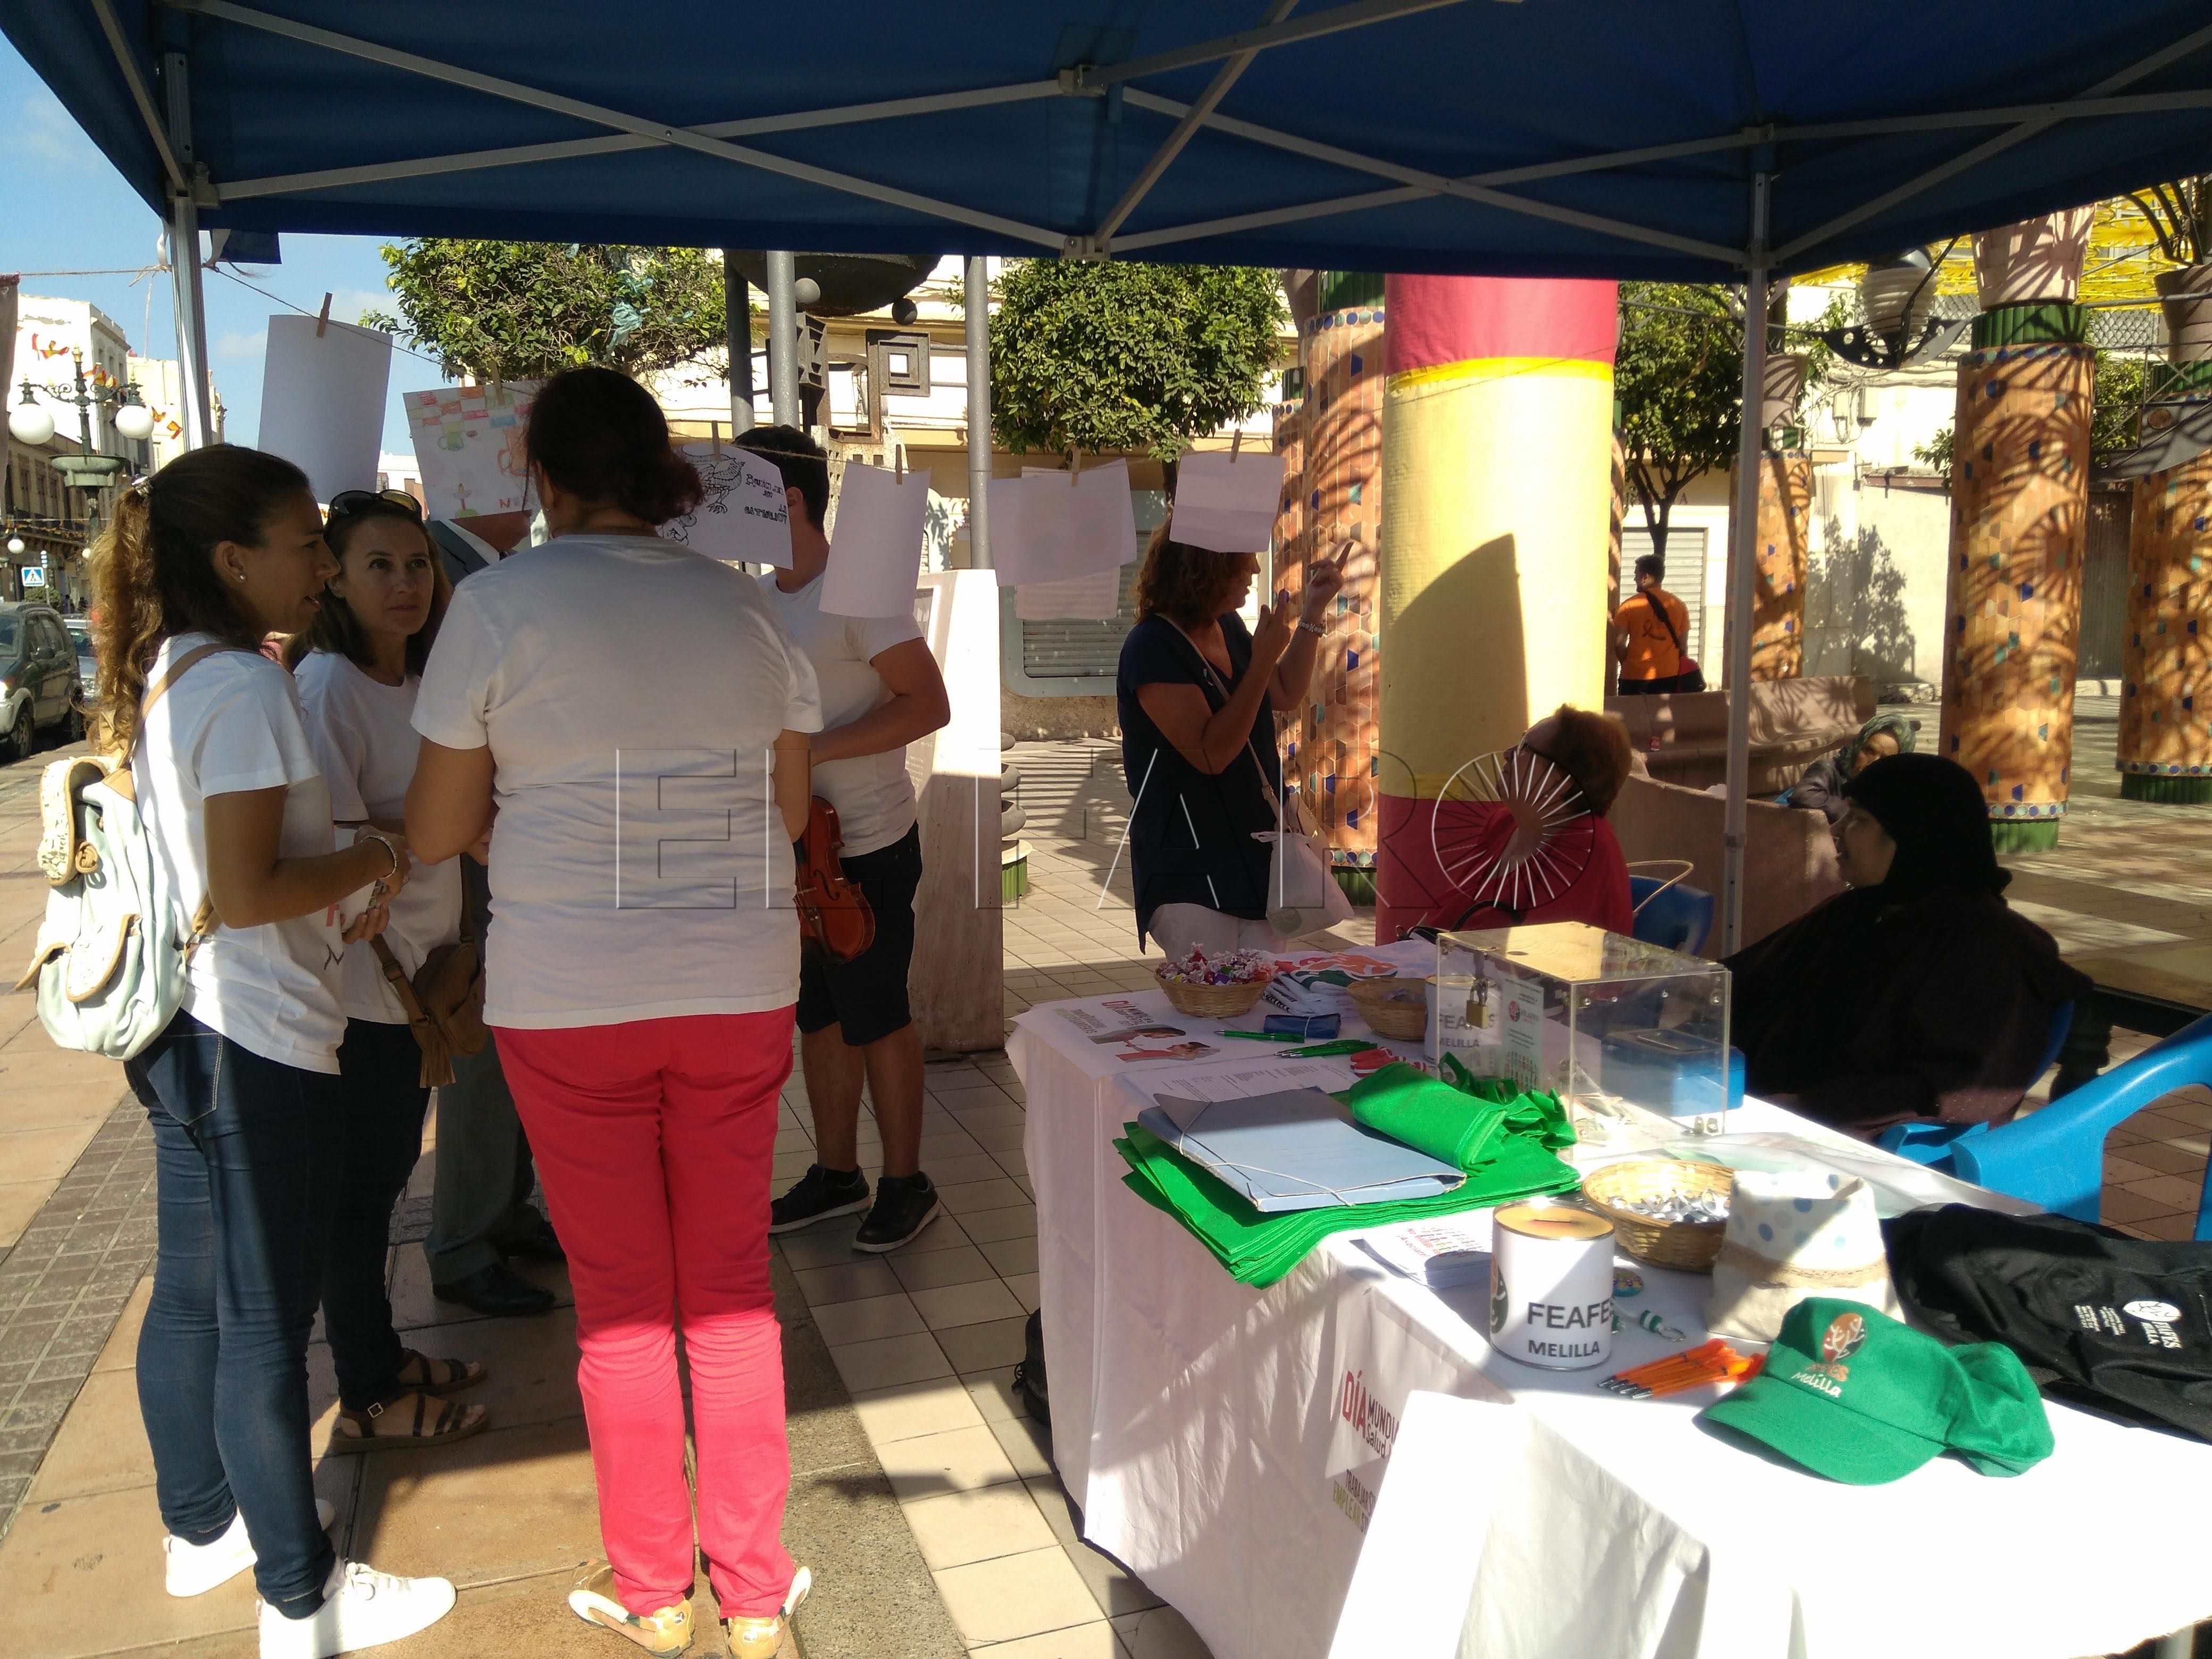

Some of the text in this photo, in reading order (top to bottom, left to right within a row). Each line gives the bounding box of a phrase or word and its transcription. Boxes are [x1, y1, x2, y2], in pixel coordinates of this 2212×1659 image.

[1527, 1298, 1613, 1329] FEAFE
[1528, 1339, 1600, 1358] MELILLA
[1342, 1370, 1367, 1439] DÍA
[1366, 1423, 1387, 1459] Salud
